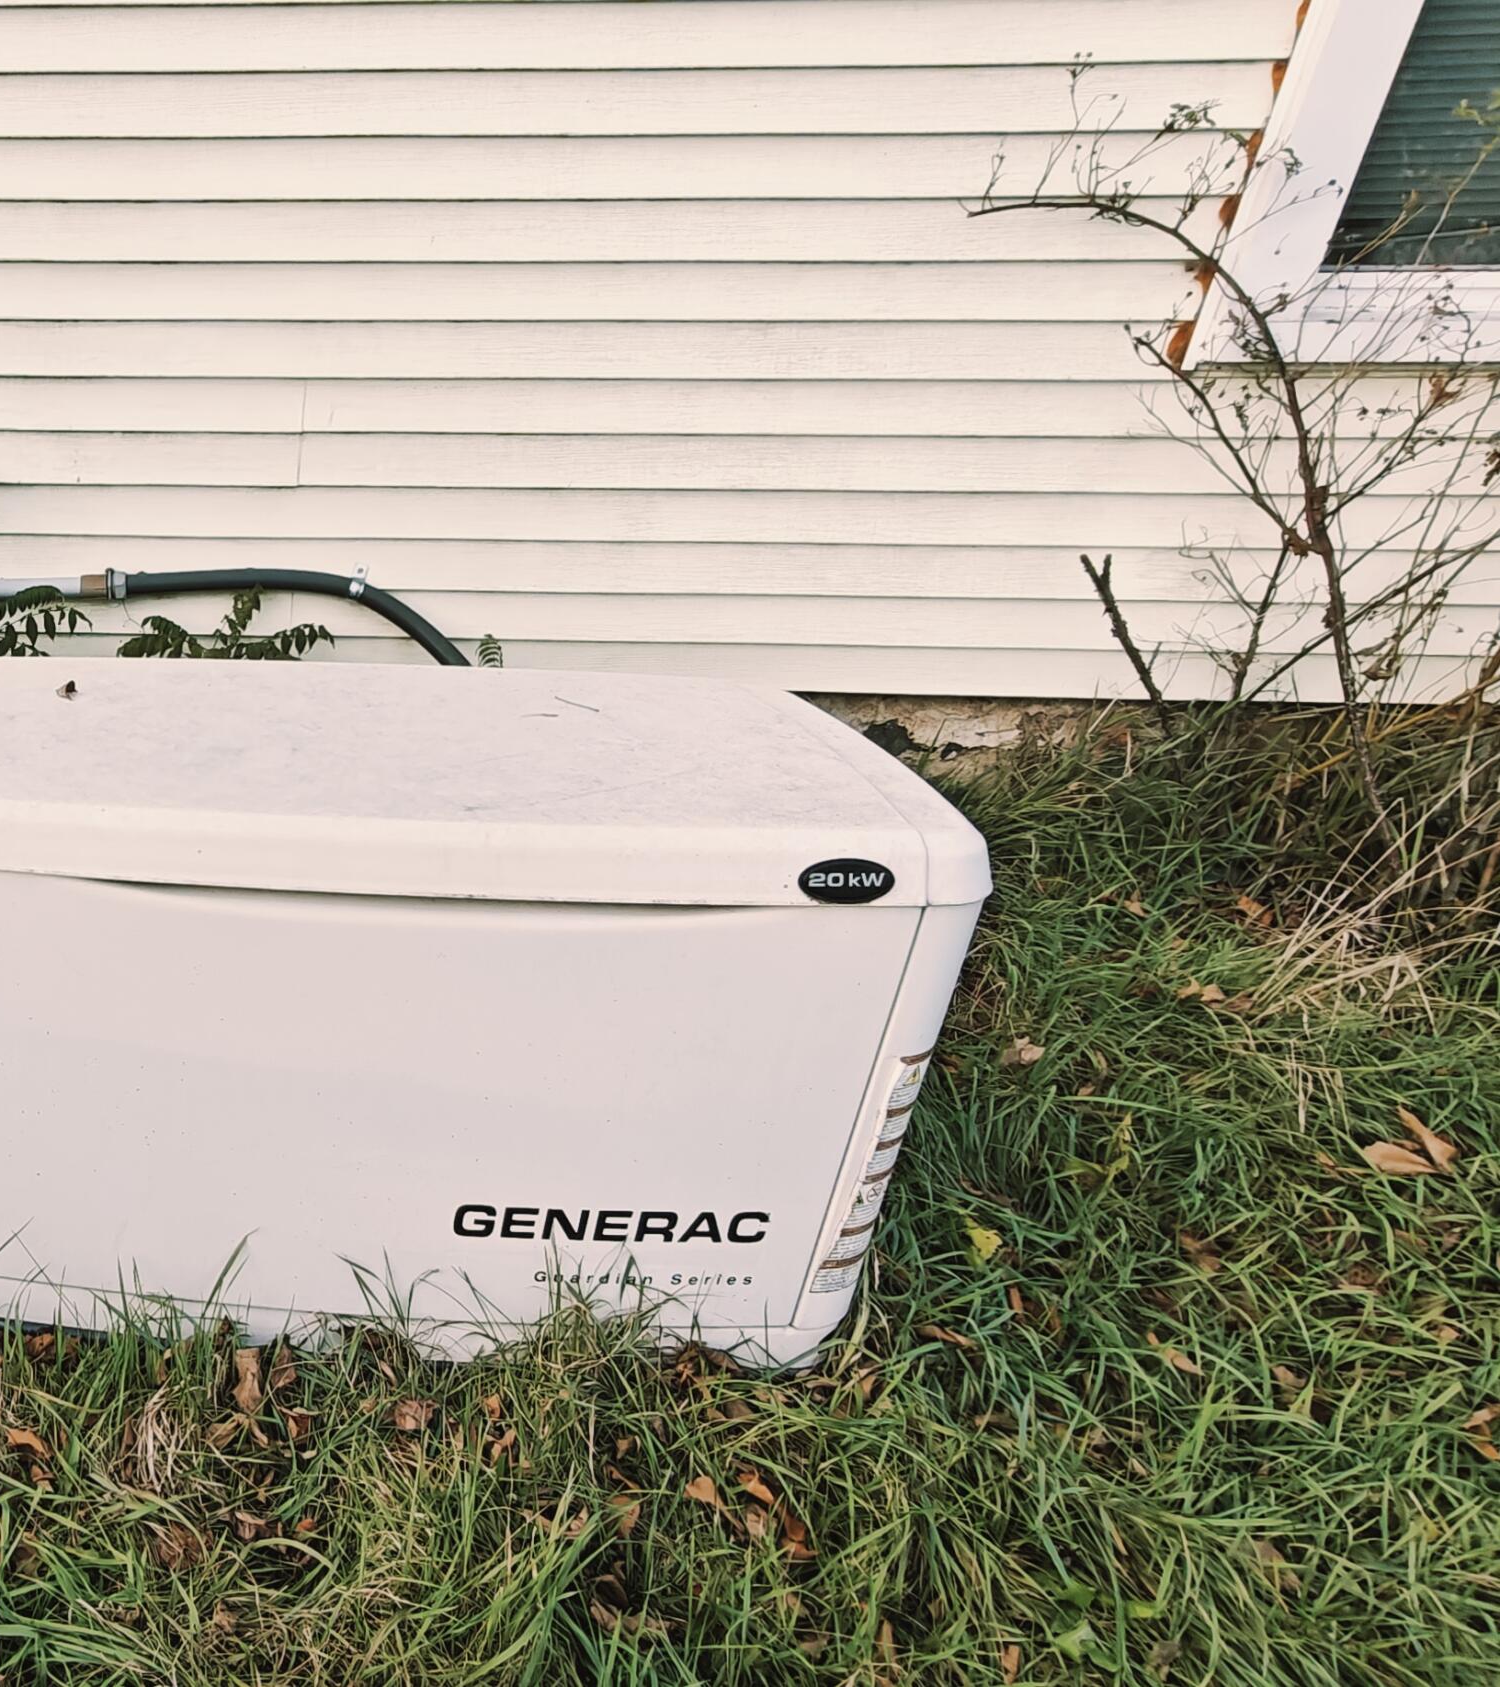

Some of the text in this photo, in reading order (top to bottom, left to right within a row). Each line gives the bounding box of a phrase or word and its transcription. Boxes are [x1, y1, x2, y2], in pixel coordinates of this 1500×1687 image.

[808, 873, 885, 887] 20 kW
[453, 1204, 769, 1243] GENERAC
[534, 1271, 753, 1286] Guardian Series
